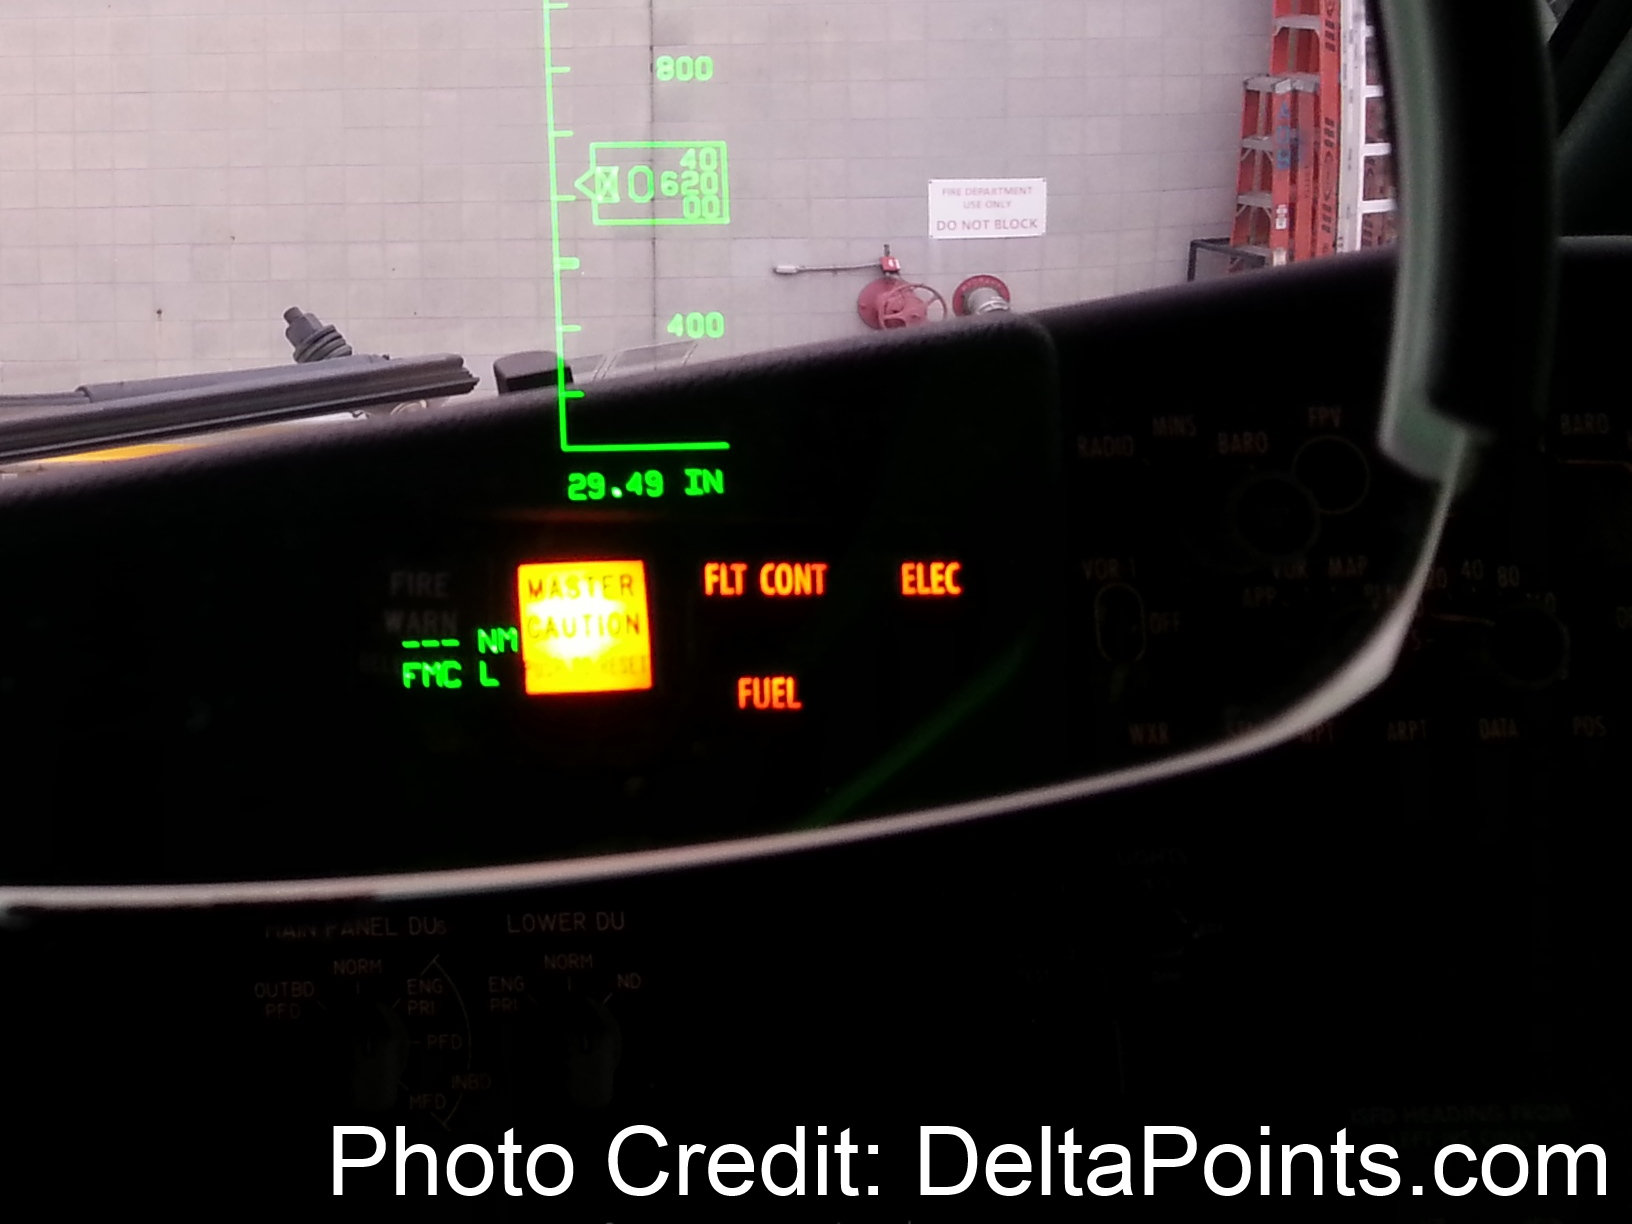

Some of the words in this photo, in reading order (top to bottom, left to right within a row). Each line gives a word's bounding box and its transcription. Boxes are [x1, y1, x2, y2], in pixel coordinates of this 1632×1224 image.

[655, 55, 714, 82] 800
[942, 188, 961, 196] FIRE
[965, 187, 1032, 196] DEPARTMENT
[937, 221, 956, 231] DO
[962, 220, 990, 230] NOT
[995, 218, 1038, 230] BLOCK
[667, 311, 725, 339] 400
[568, 470, 665, 500] 29.49
[685, 468, 725, 495] IN
[527, 573, 635, 600] MASTER
[704, 562, 747, 595] FLT
[759, 561, 828, 595] CONT
[901, 561, 961, 595] ELEC
[527, 612, 641, 639] CAUTION
[476, 627, 519, 654] NM
[402, 659, 462, 689] FMC
[478, 659, 500, 687] L
[738, 676, 802, 709] FUEL
[505, 911, 587, 934] LOWER
[595, 910, 627, 931] DU
[542, 952, 595, 971] NORM
